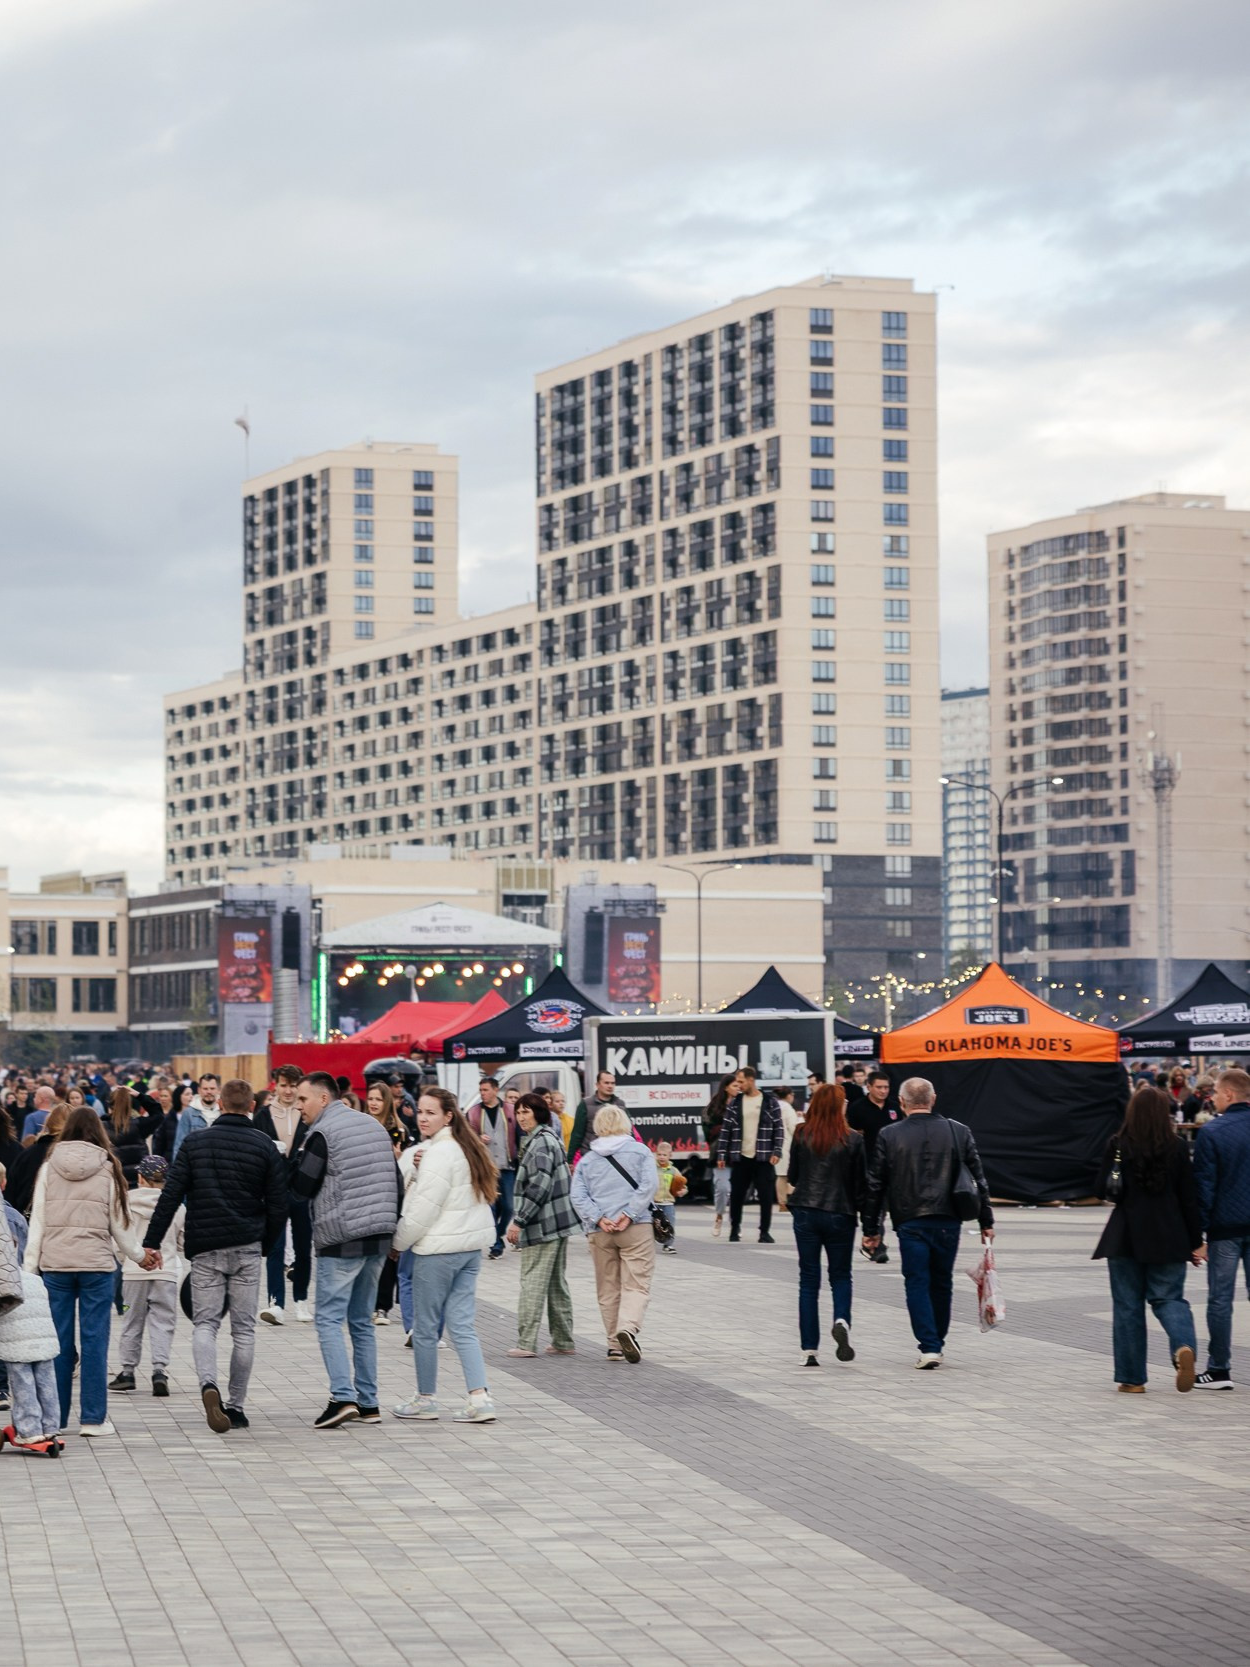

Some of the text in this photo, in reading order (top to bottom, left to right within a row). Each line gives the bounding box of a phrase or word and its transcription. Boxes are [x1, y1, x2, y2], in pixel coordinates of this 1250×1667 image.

[974, 1014, 1019, 1023] JOE'S
[925, 1036, 1072, 1052] OKLAHOMA JOE'S
[1193, 1040, 1222, 1048] PRIME
[523, 1046, 580, 1054] PRIME LINER
[606, 1044, 748, 1076] КАМИНЫ
[661, 1090, 702, 1101] Dimplex
